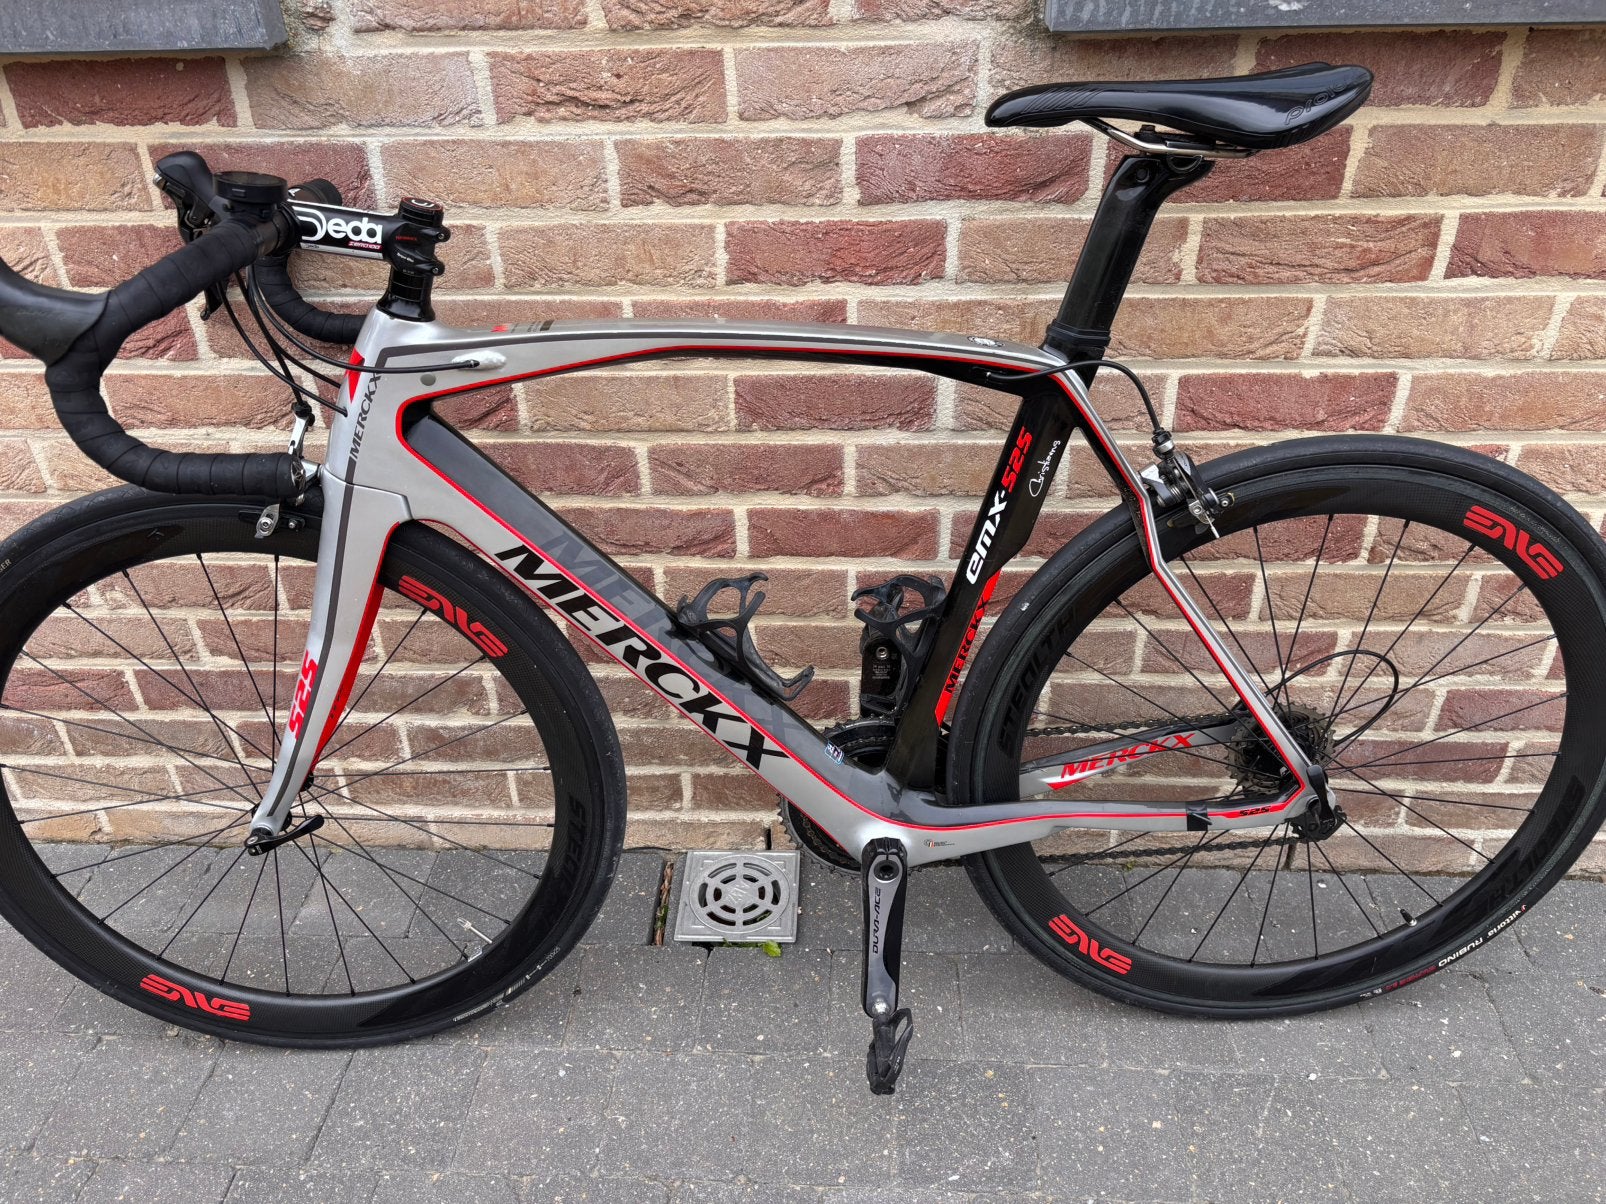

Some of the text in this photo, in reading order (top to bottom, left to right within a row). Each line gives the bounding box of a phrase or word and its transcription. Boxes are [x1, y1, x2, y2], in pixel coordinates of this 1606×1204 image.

[292, 205, 383, 245] Deda
[349, 371, 381, 459] MERCKX
[1463, 505, 1564, 580] ENVE
[398, 575, 509, 658] ENVE
[944, 596, 989, 694] MERCKX
[494, 544, 790, 770] MERCKX
[1060, 733, 1194, 779] MERCKX
[872, 886, 882, 955] DURA-ACE
[1048, 914, 1133, 975] ENVE
[1438, 937, 1484, 967] RUBINO
[139, 974, 251, 1021] ENVE
